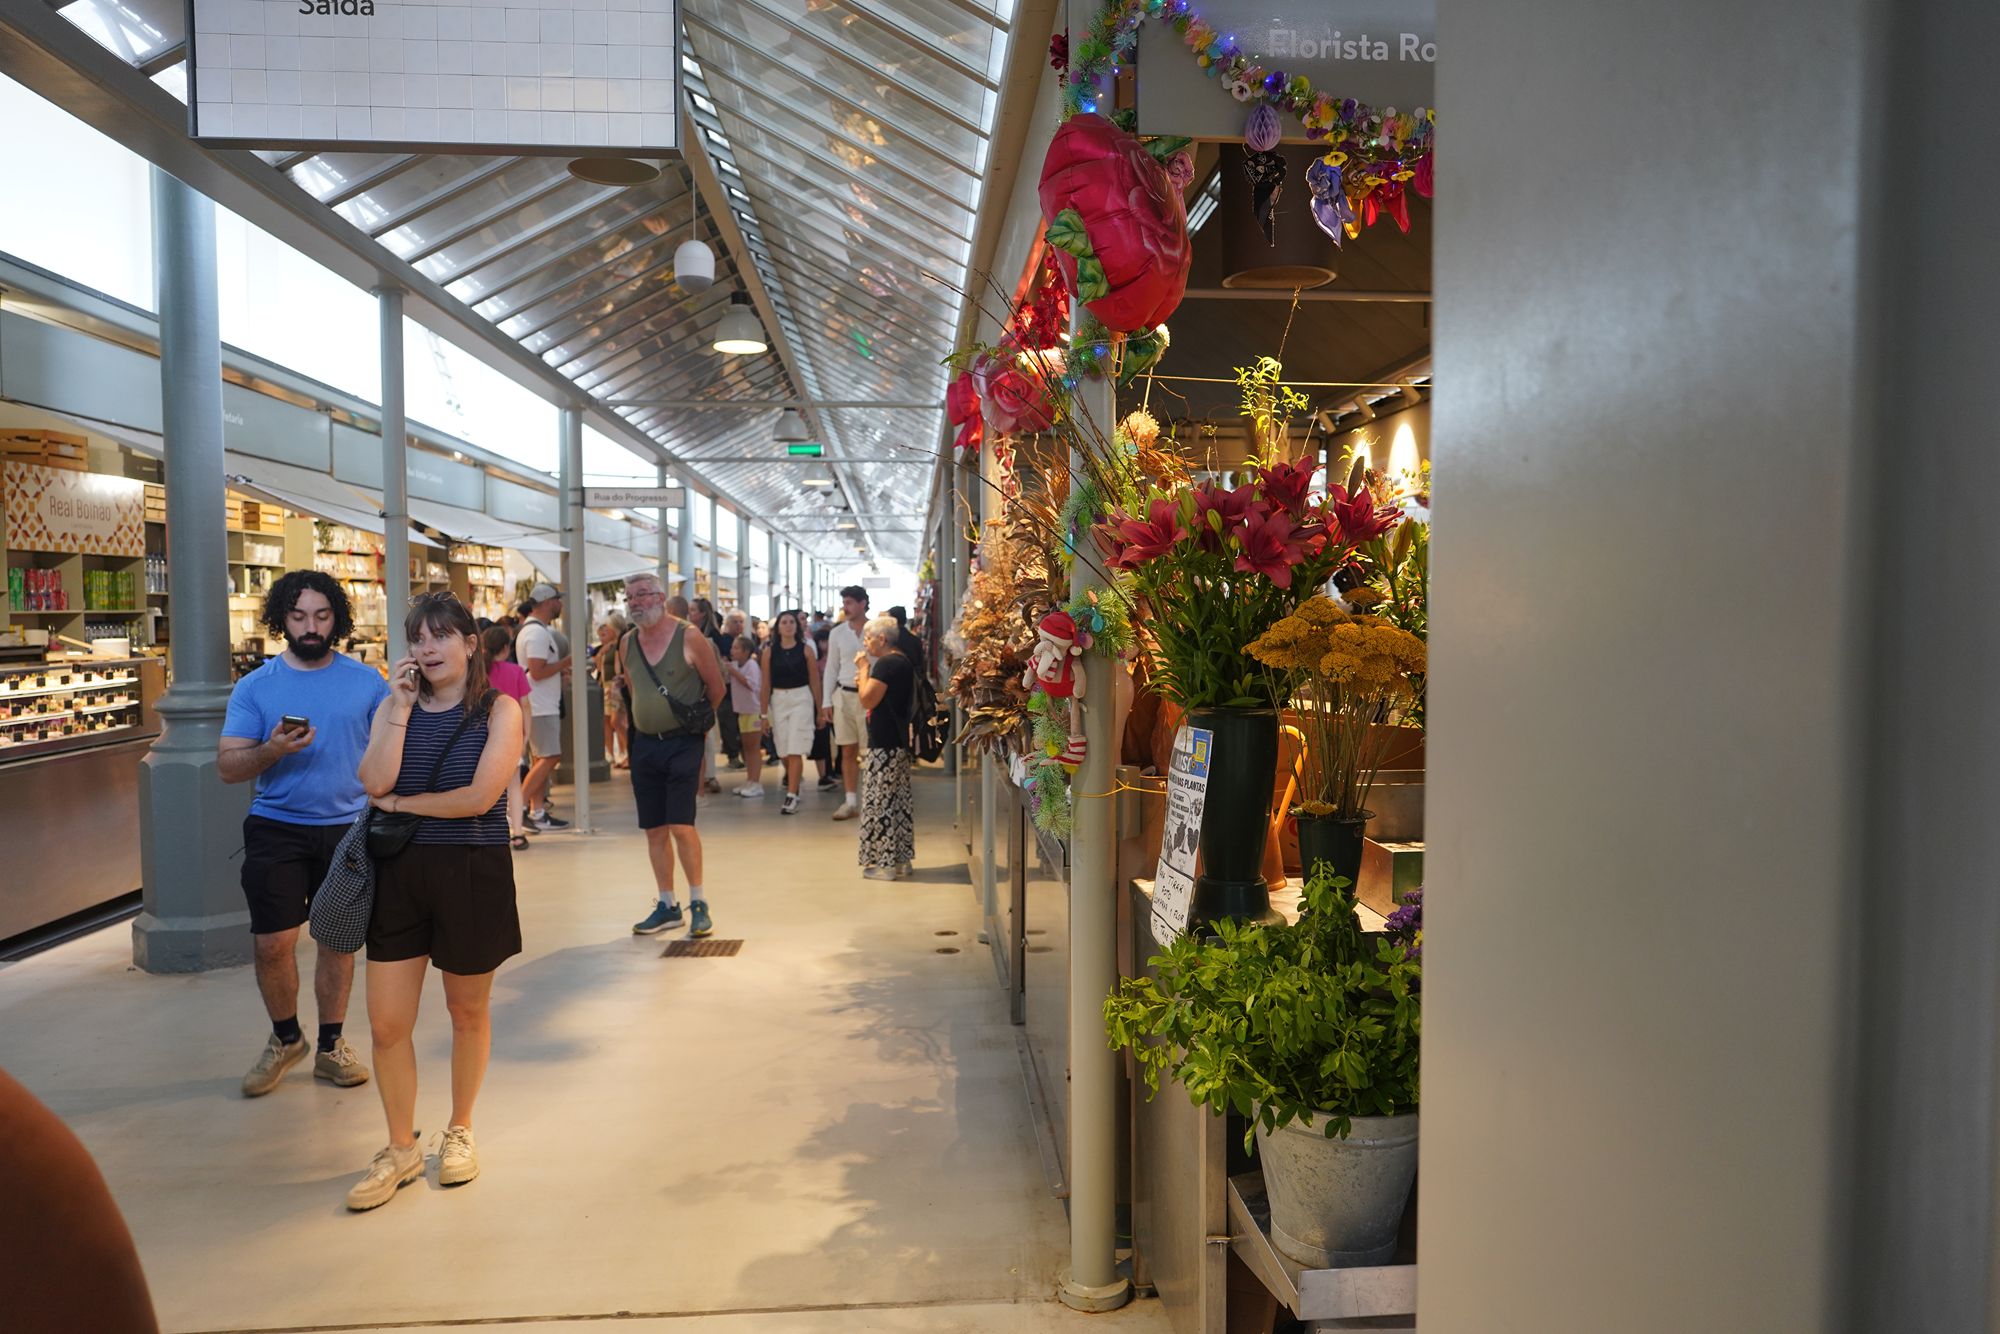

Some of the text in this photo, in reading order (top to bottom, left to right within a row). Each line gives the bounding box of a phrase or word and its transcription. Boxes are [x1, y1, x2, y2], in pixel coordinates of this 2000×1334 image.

[1268, 28, 1389, 62] Florista
[49, 495, 73, 518] Real
[594, 492, 669, 504] Rua do Progresso
[1184, 779, 1205, 793] PLANTAS
